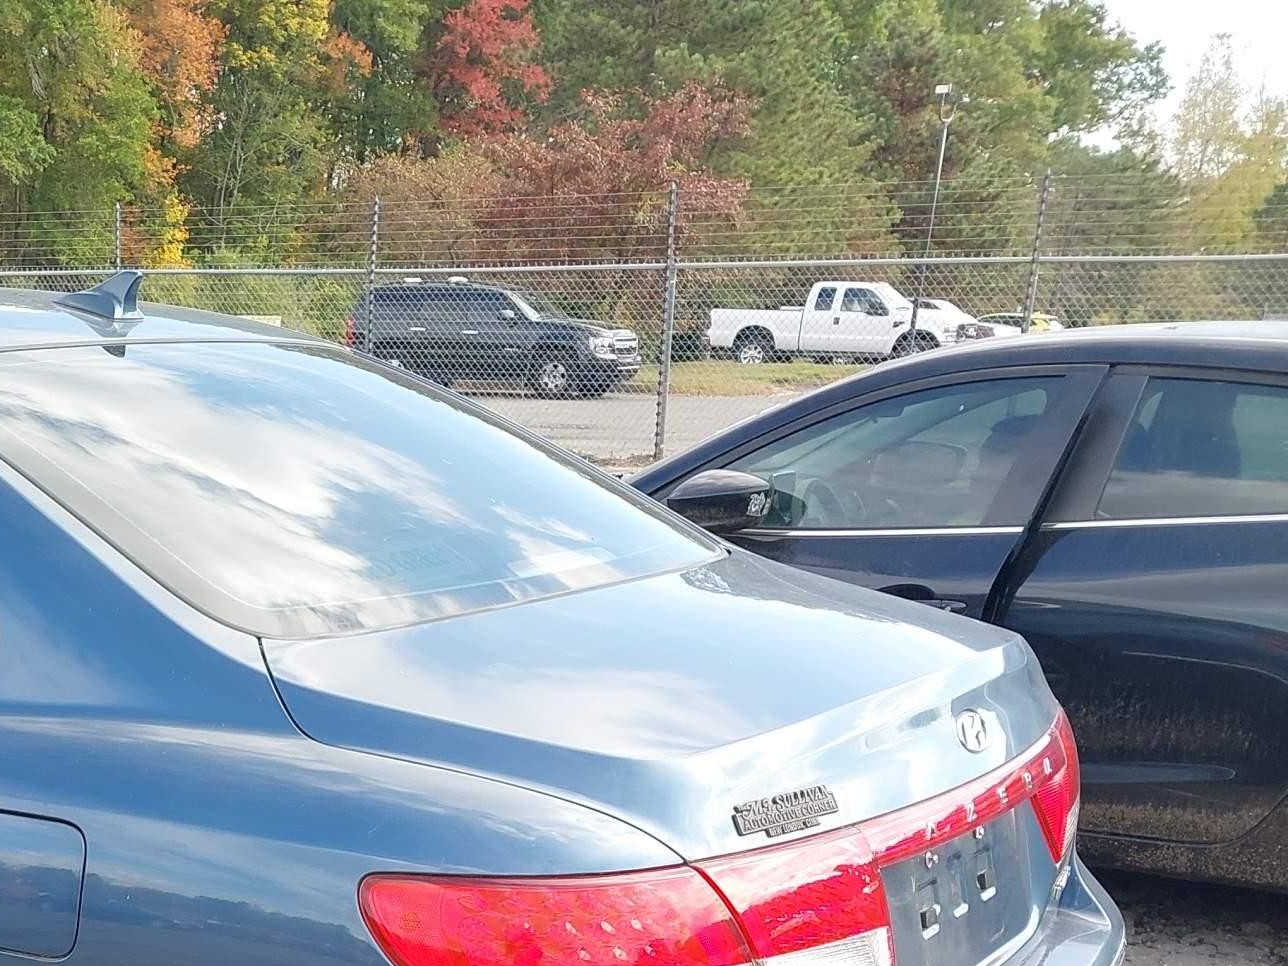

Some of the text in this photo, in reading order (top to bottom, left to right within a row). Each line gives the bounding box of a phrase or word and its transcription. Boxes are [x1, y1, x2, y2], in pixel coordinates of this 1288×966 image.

[775, 785, 829, 810] SULLIVAN
[743, 799, 836, 831] AUTOMOTIVE CORNER
